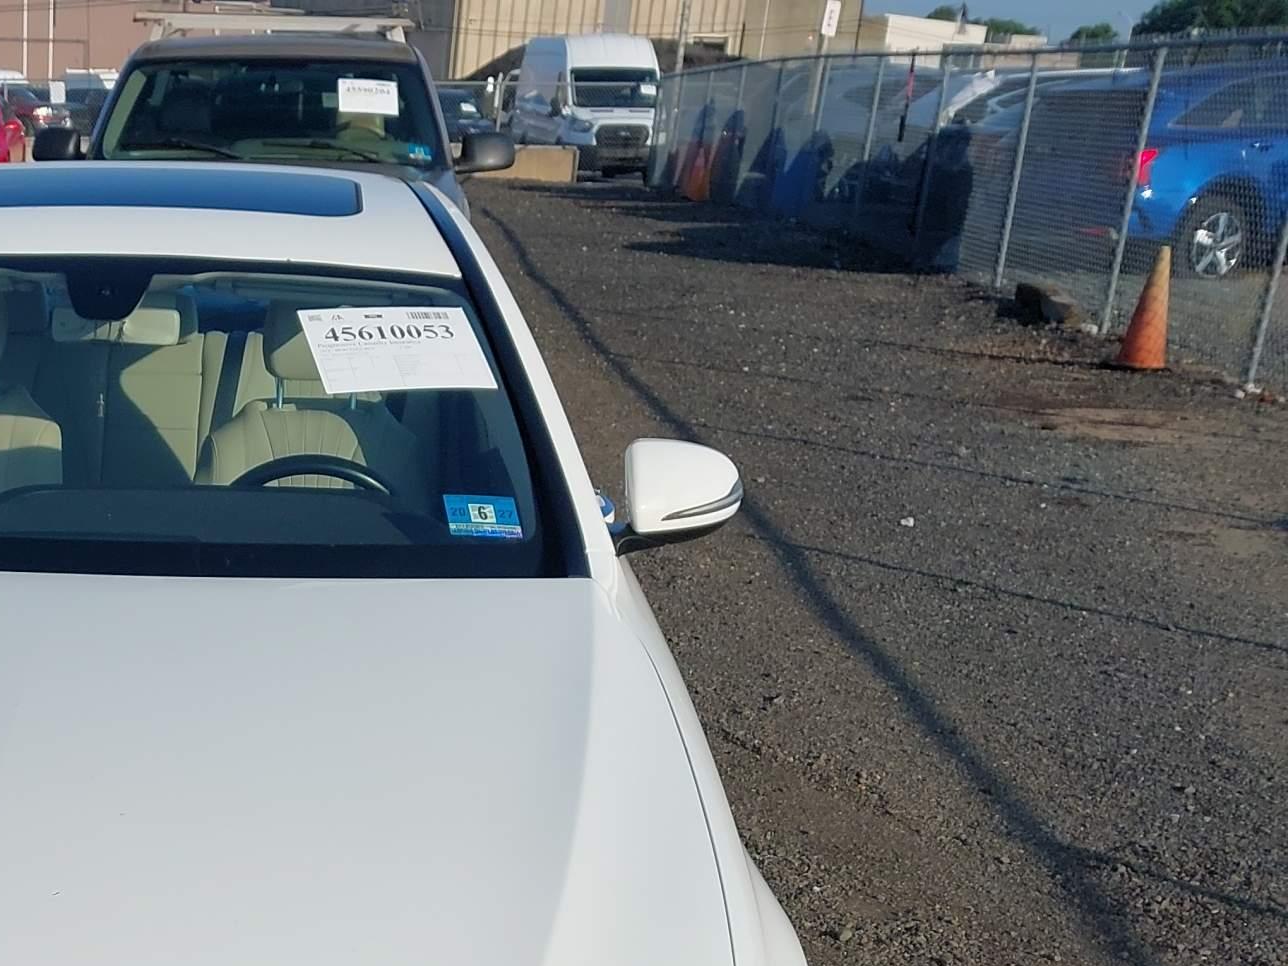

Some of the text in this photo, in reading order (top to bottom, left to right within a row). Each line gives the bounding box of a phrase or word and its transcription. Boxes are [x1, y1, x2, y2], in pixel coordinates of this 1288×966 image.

[324, 324, 454, 342] 45610053
[450, 507, 466, 516] 20
[478, 506, 488, 520] 6
